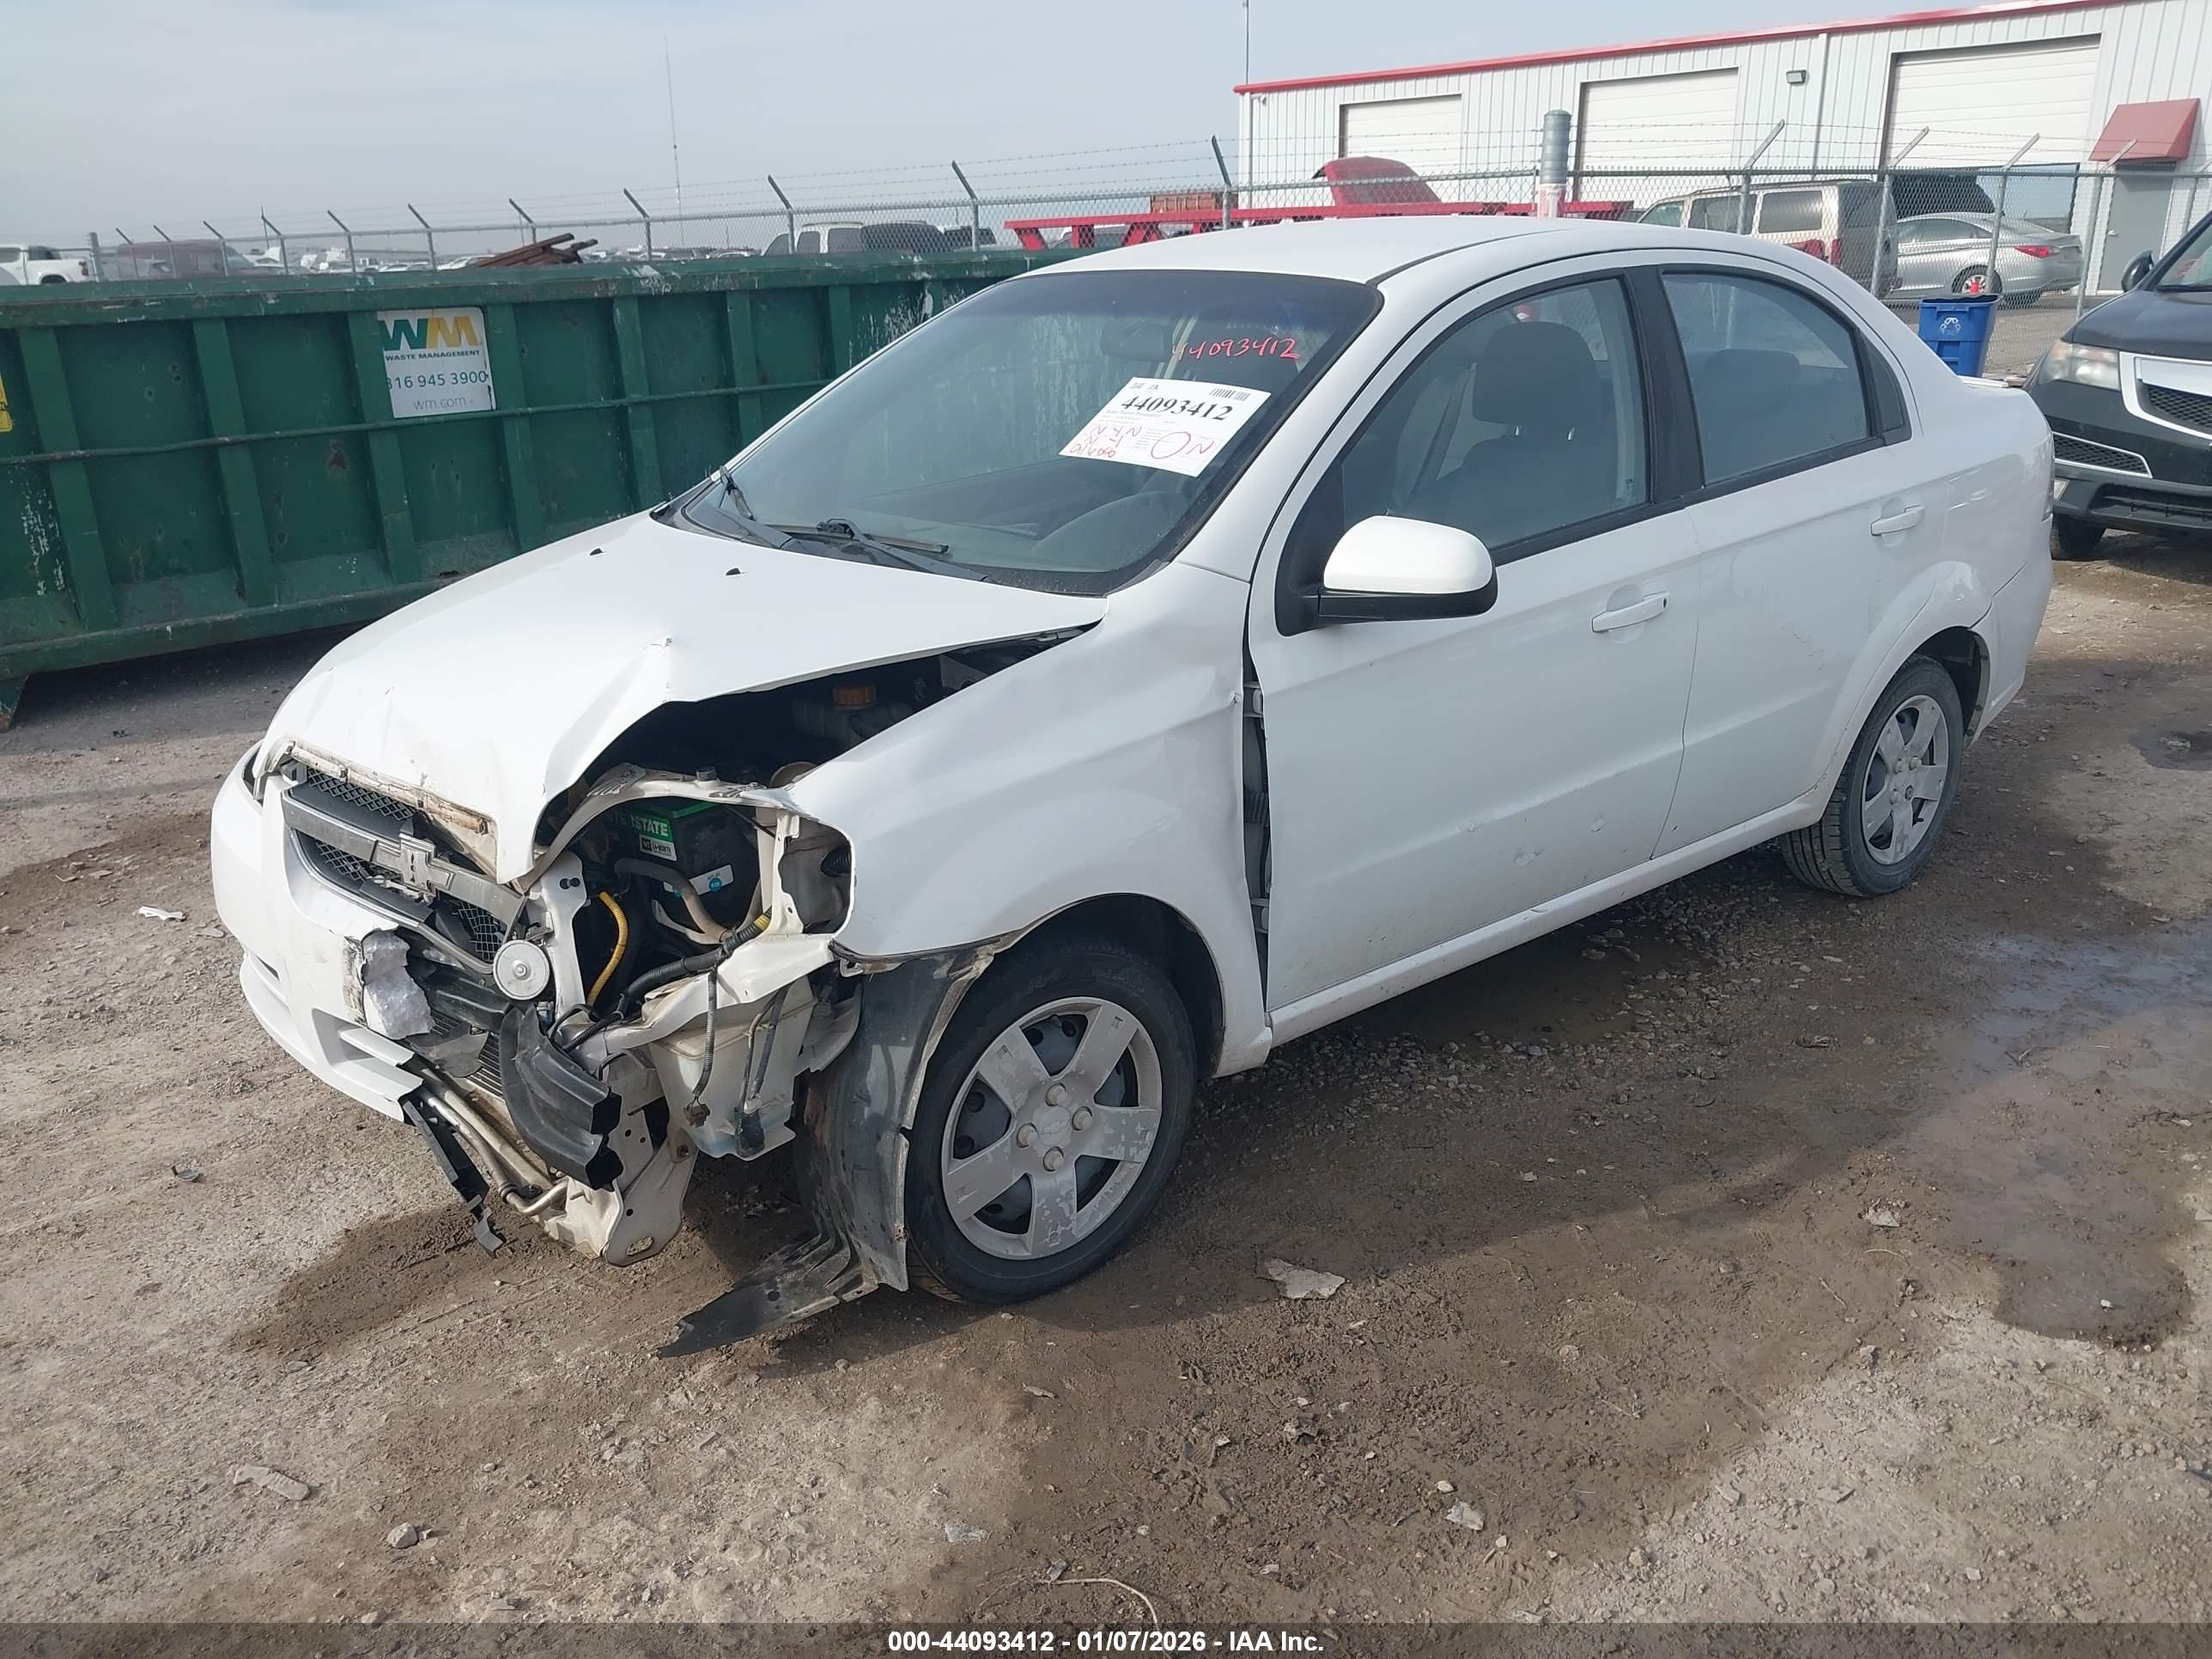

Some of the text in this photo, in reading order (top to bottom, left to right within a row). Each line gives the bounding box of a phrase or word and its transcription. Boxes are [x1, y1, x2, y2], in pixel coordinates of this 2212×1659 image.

[380, 315, 479, 351] WM
[418, 350, 480, 359] MANAGEMENT
[1172, 336, 1301, 362] 44093412
[418, 373, 446, 388] 945
[451, 371, 487, 385] 3900
[413, 396, 466, 411] wm.com
[1121, 396, 1233, 422] 44093412
